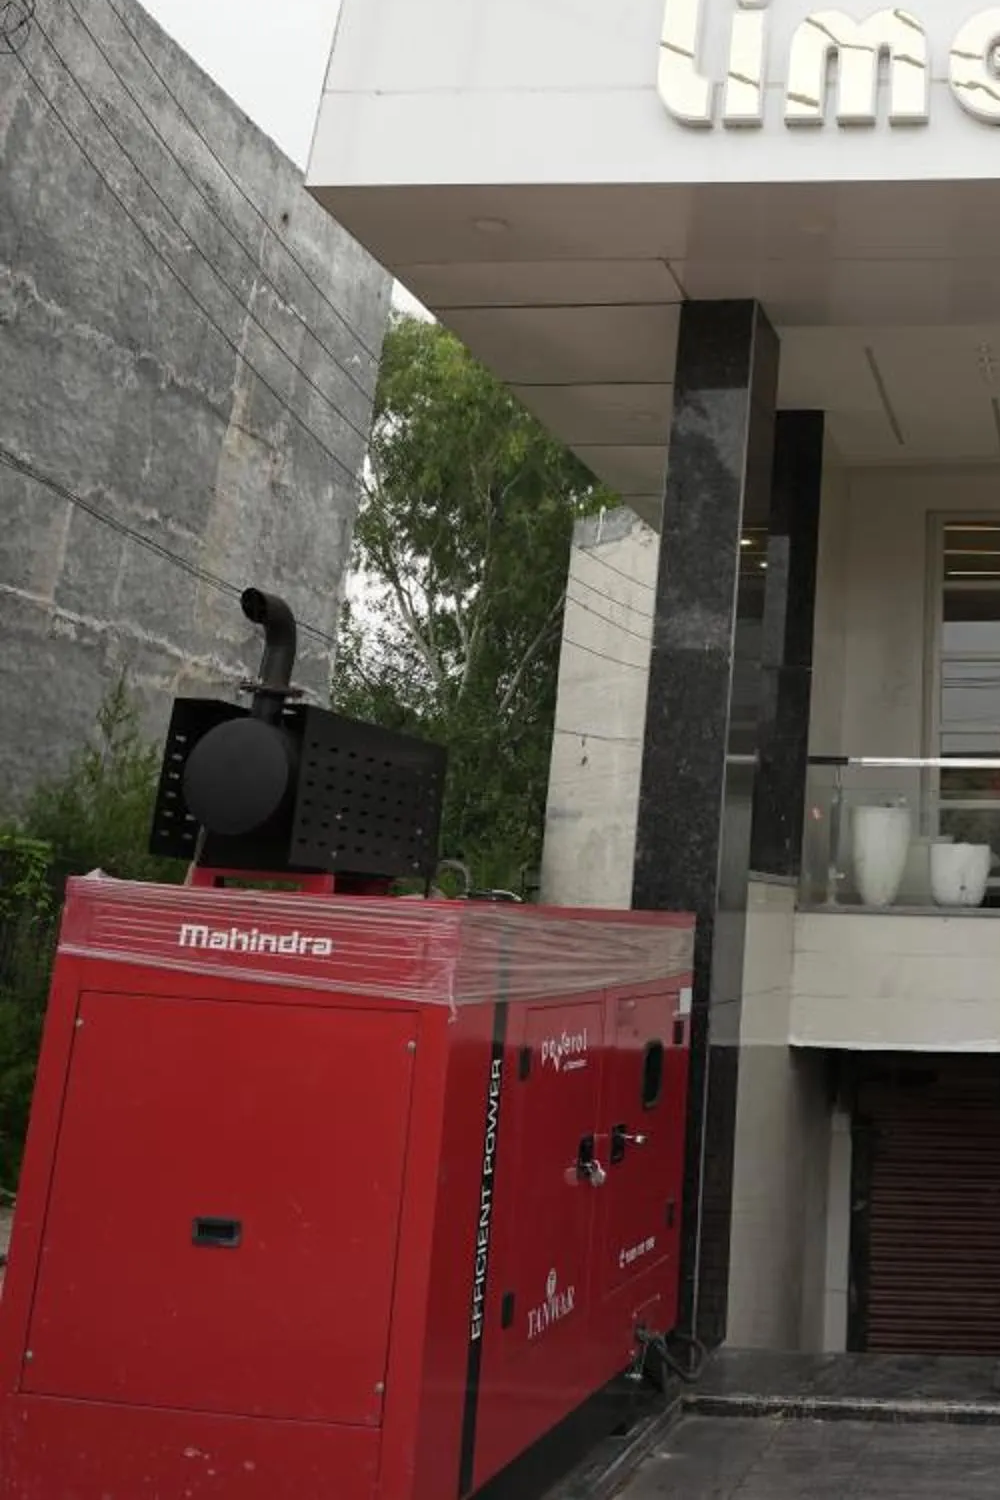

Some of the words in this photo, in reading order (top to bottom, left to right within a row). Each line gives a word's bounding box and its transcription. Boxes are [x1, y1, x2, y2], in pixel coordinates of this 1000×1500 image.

[178, 923, 333, 956] Mahindra
[471, 1185, 491, 1341] EFFICIENT
[483, 1059, 502, 1175] POWER
